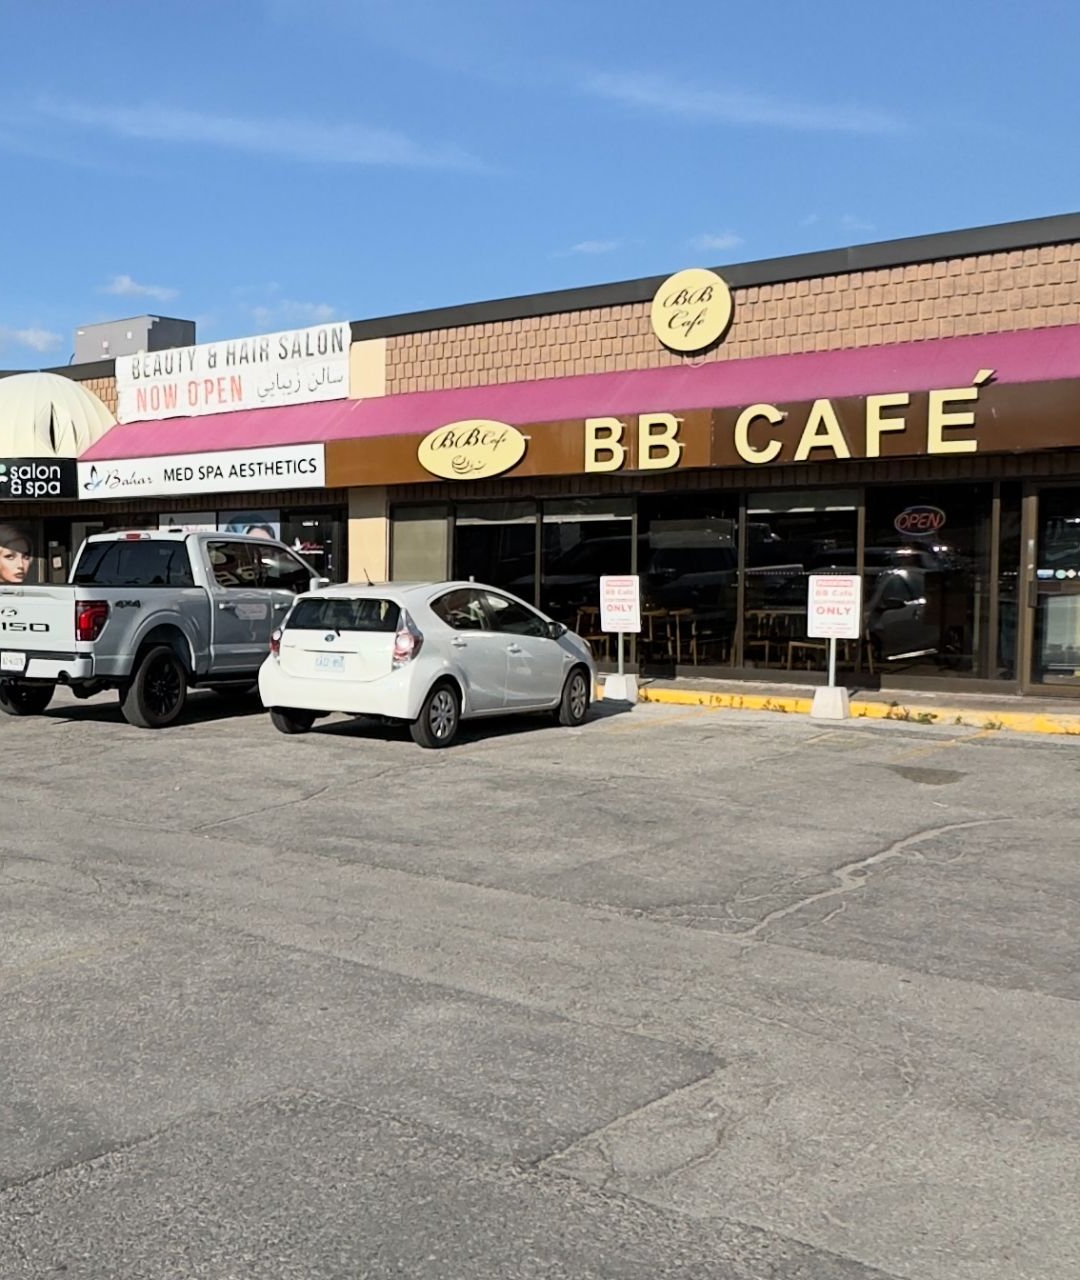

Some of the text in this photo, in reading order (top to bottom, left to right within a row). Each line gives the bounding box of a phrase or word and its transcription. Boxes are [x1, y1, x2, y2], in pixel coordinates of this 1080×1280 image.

[663, 282, 718, 308] BB
[132, 326, 344, 380] BEAUTY & HAIR SALON
[136, 375, 243, 413] NOW OPEN
[584, 368, 996, 473] BB CAFÉ
[10, 463, 61, 479] salon
[163, 467, 194, 482] MED
[198, 465, 224, 480] SPA
[228, 457, 318, 478] AESTHETICS
[10, 479, 61, 498] & spa
[897, 513, 940, 529] OPEN
[606, 604, 633, 612] ONLY
[815, 606, 851, 616] ONLY
